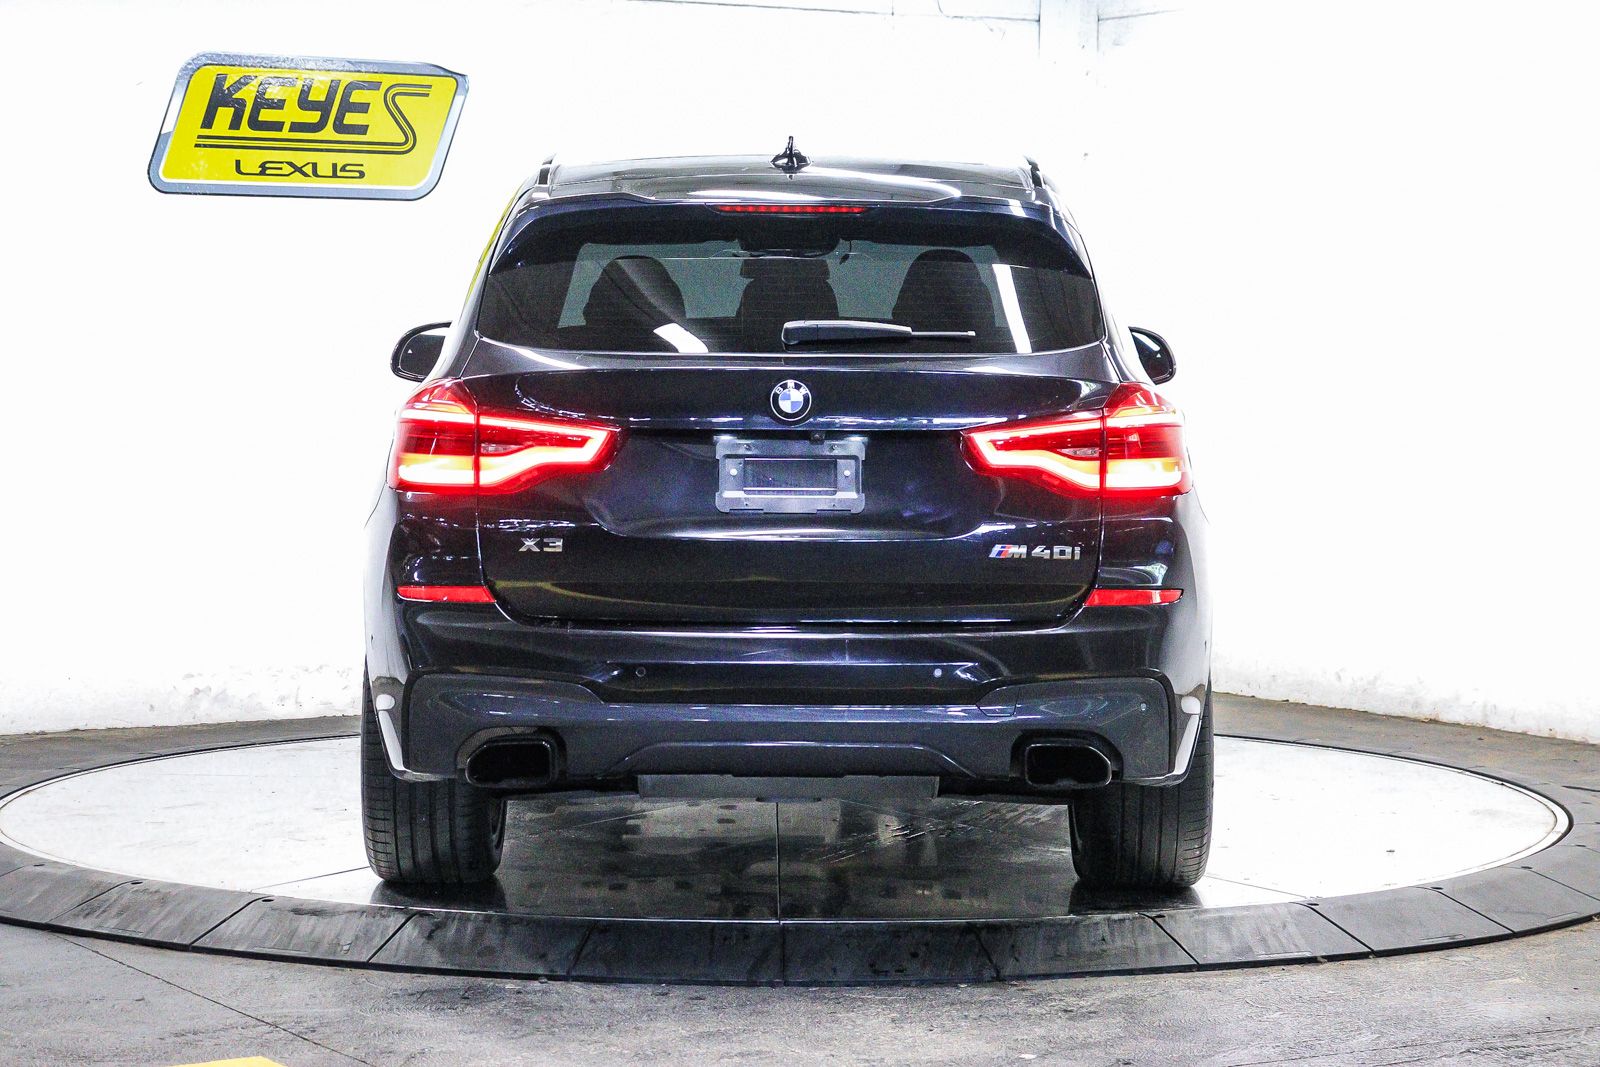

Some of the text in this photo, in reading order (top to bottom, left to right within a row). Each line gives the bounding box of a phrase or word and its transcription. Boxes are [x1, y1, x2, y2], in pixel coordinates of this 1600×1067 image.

[199, 73, 433, 153] KEYES
[235, 159, 365, 179] LEXUS
[775, 380, 808, 396] BMW
[519, 538, 563, 552] X3
